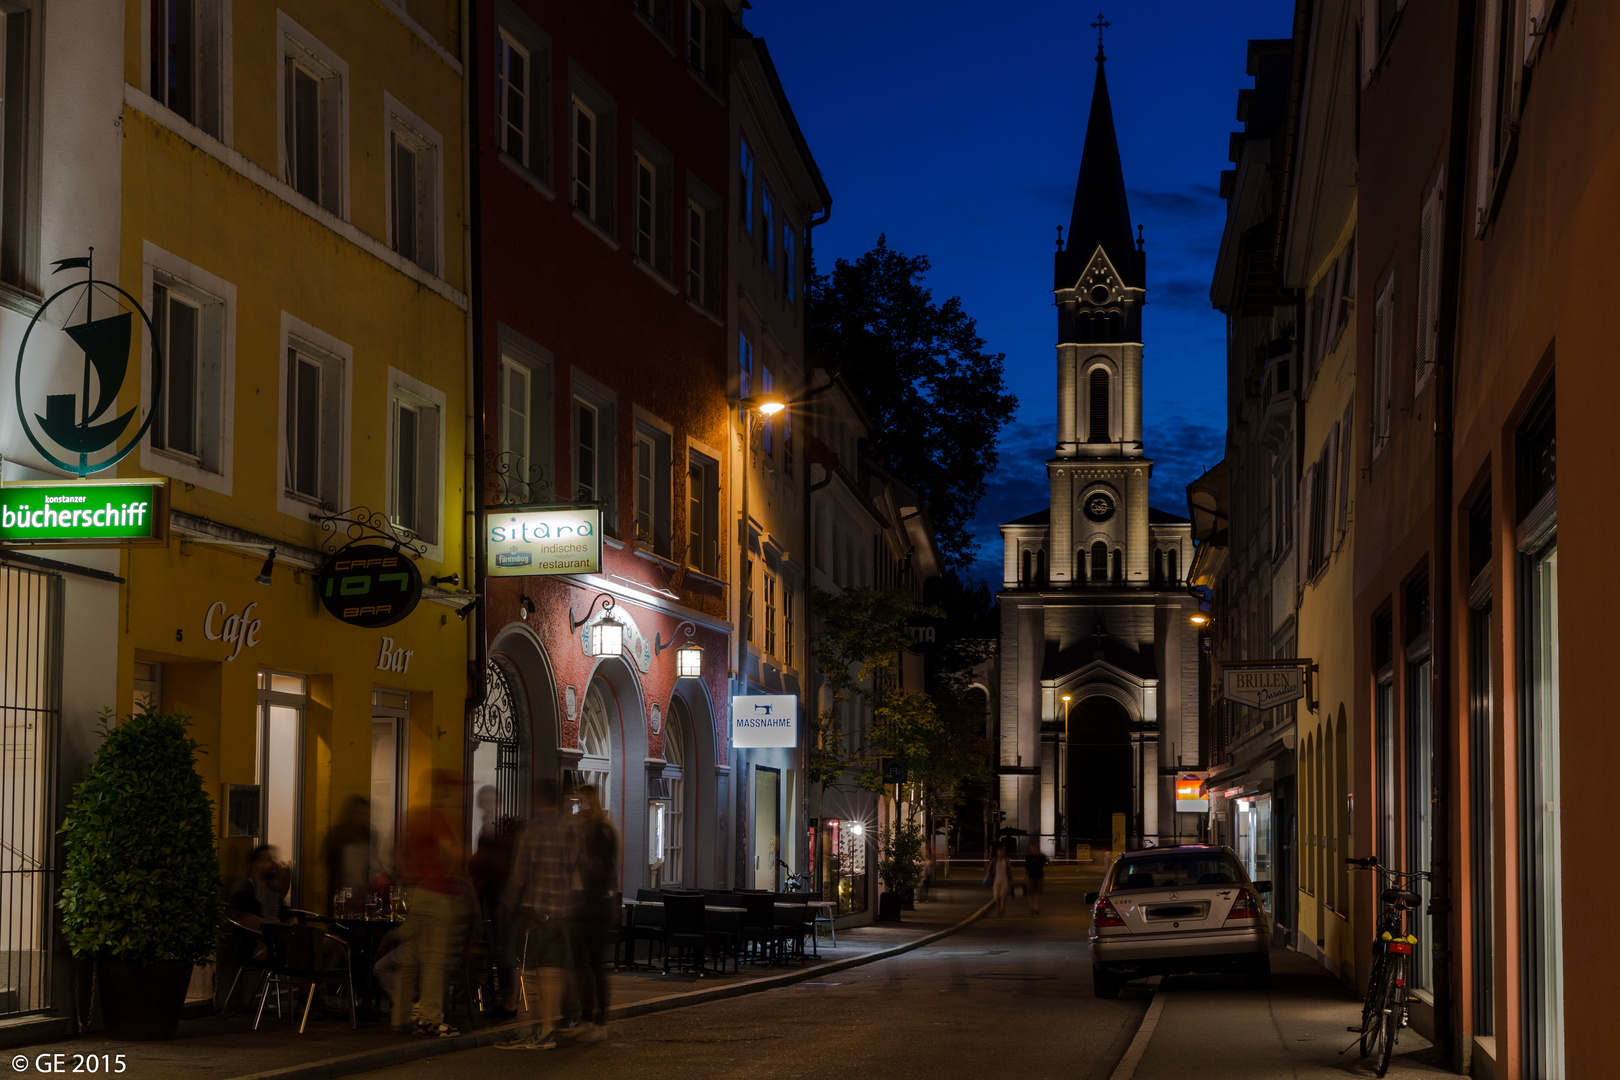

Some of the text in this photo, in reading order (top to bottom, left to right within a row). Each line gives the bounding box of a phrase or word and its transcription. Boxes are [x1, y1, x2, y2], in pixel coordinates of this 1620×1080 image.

[45, 494, 87, 504] konstanzer
[2, 502, 148, 528] bücherschiff
[491, 516, 594, 544] sitara
[540, 543, 588, 554] indisches
[334, 557, 399, 571] CAFE
[539, 558, 590, 569] restaurant
[325, 572, 409, 598] 107
[343, 604, 392, 618] BAR
[175, 628, 183, 642] 5
[203, 601, 262, 662] Cafe
[375, 636, 414, 674] Bar
[1236, 672, 1291, 689] BRILLEN
[1257, 684, 1297, 708] Paradies
[736, 718, 792, 728] MASSNAHME
